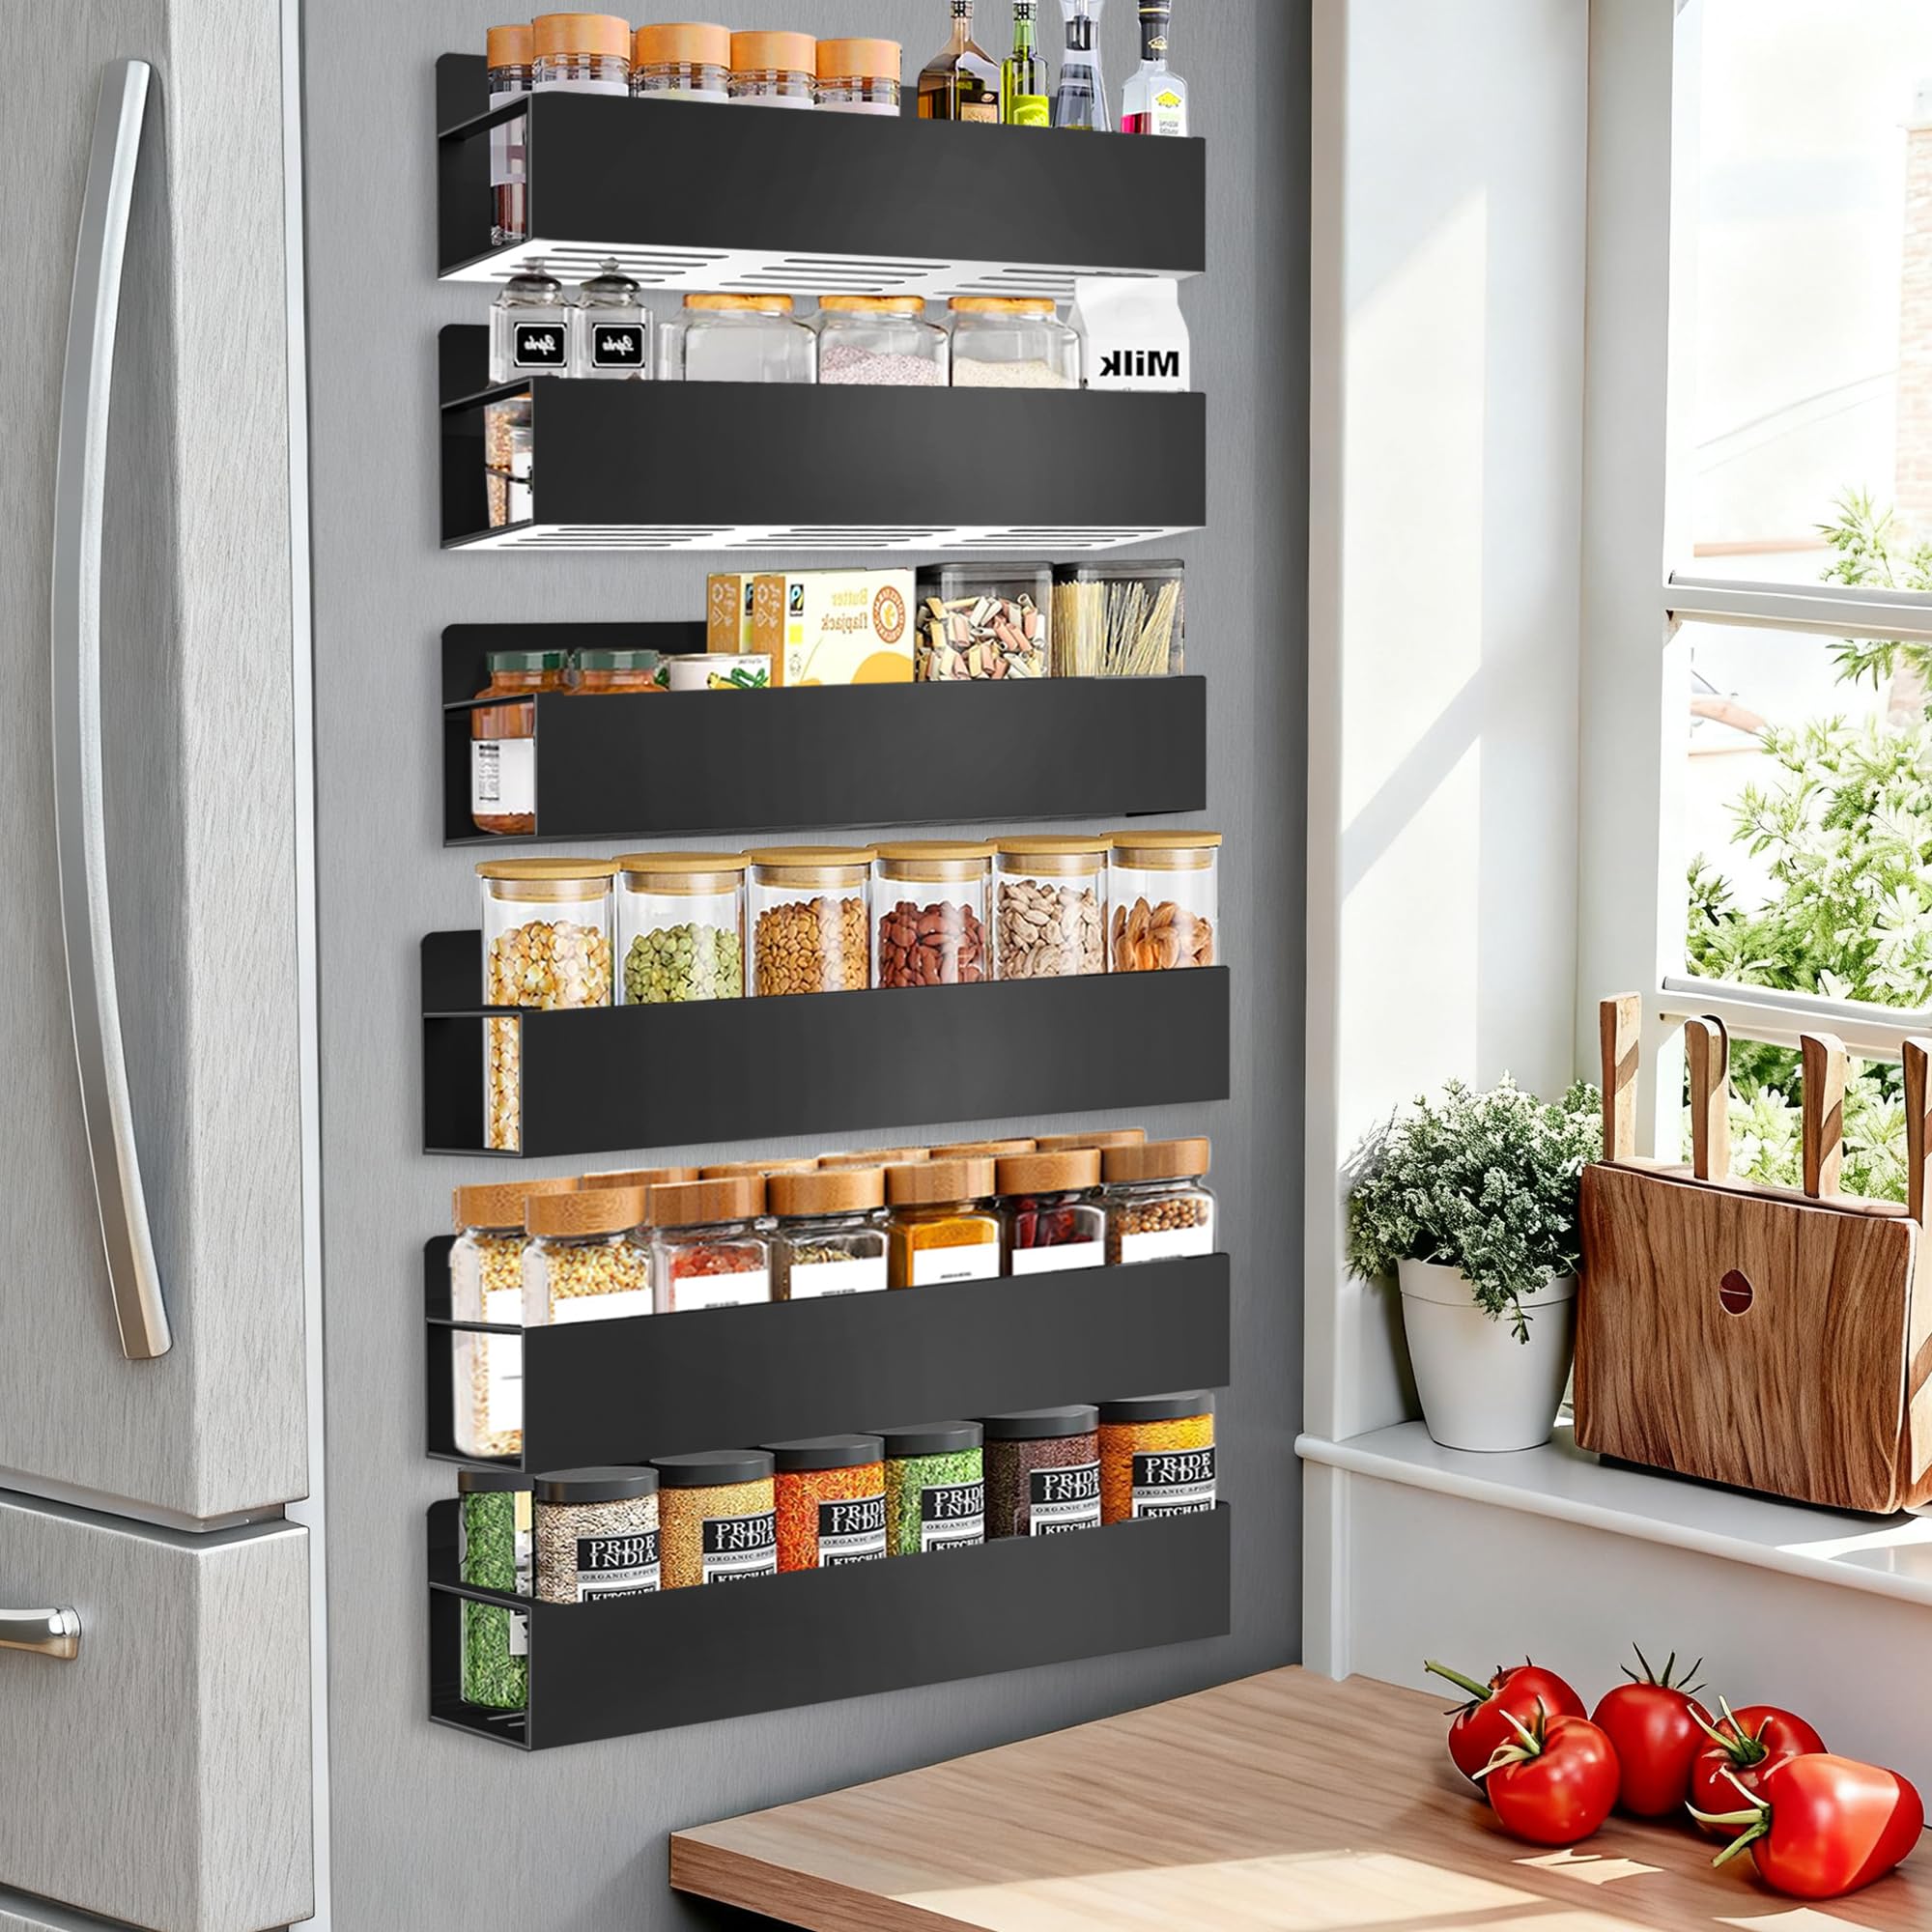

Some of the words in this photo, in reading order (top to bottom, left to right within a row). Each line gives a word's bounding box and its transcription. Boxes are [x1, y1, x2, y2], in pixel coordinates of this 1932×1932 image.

[1146, 1452, 1210, 1471] PRIDE
[1043, 1467, 1099, 1489] PRIDE
[1146, 1465, 1213, 1484] INDIA
[1043, 1482, 1100, 1501] INDIA
[832, 1499, 885, 1520] PRIDE
[716, 1516, 775, 1537] PRIDE
[832, 1513, 886, 1534] INDIA
[590, 1534, 656, 1554] PRIDE
[716, 1530, 776, 1550] INDIA
[589, 1548, 658, 1568] INDIA
